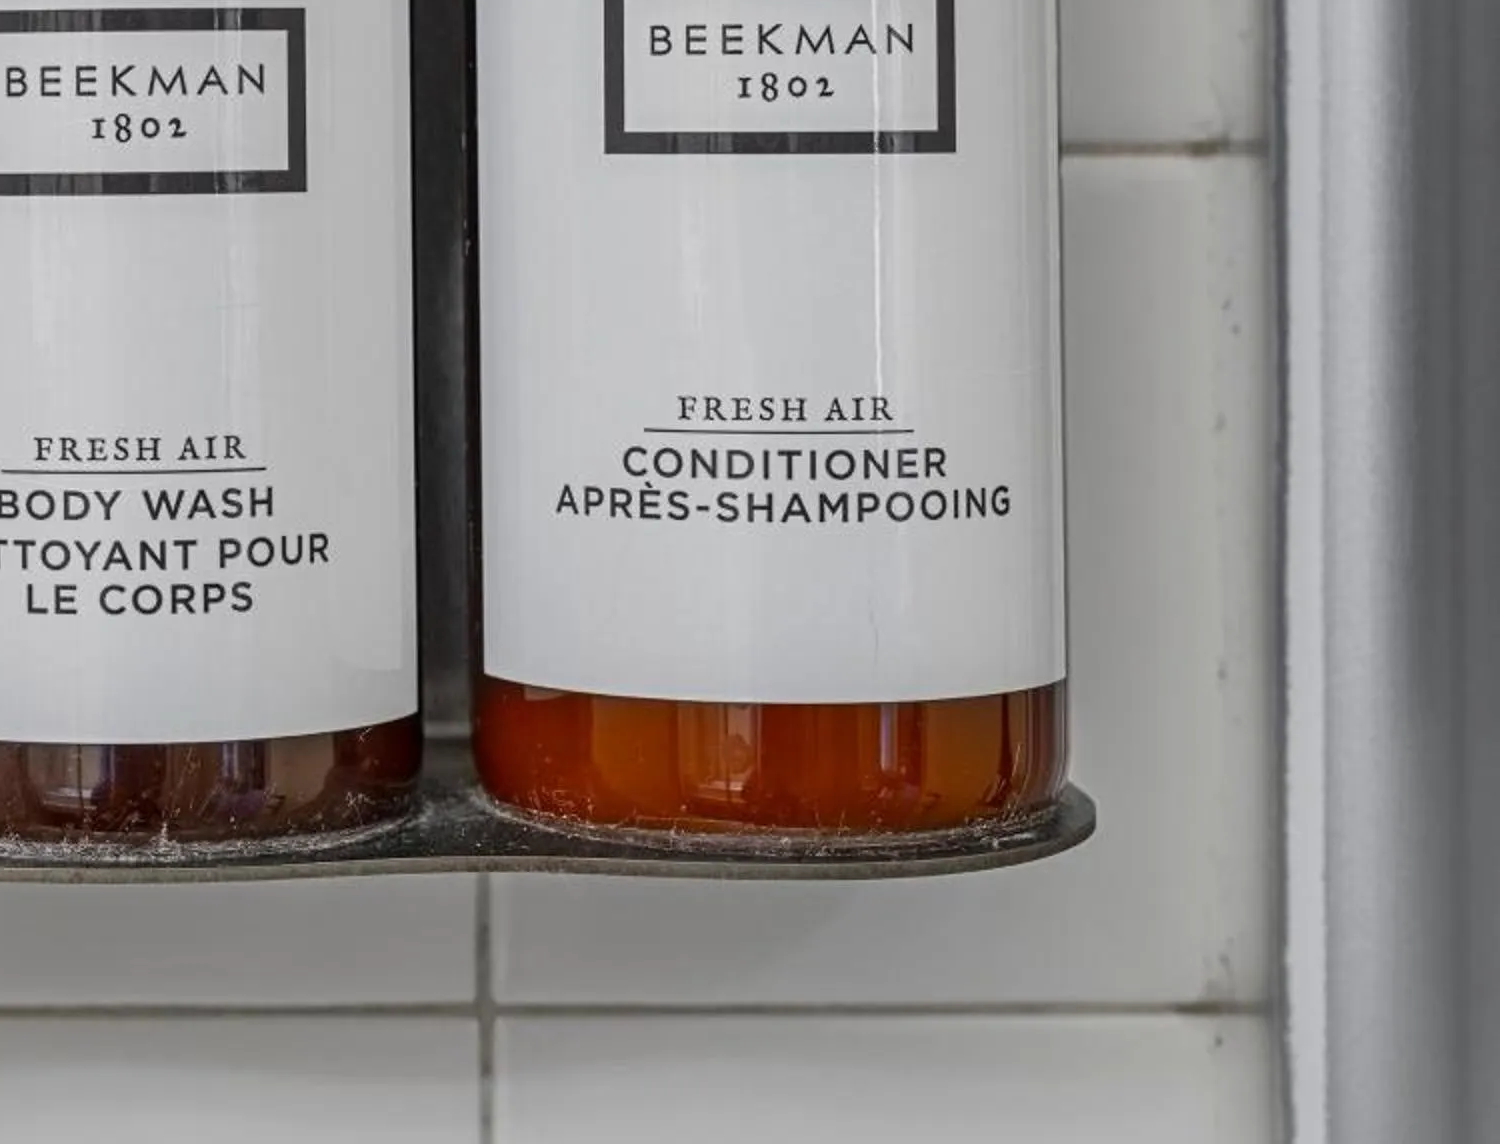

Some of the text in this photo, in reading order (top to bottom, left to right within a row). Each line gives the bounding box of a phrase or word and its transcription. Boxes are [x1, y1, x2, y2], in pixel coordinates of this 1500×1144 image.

[649, 23, 914, 57] BEEKMAN
[5, 63, 265, 98] BEEKMAN
[737, 71, 835, 103] 1802
[91, 112, 188, 144] 1802
[676, 395, 894, 422] FRESH AIR
[32, 434, 247, 463] FRESH AIR
[622, 445, 947, 481] CONDITIONER
[141, 485, 274, 521] WASH
[555, 482, 1011, 524] APRÈS-SHAMPOOING
[218, 532, 329, 569] POUR
[26, 581, 254, 616] LE CORPS
